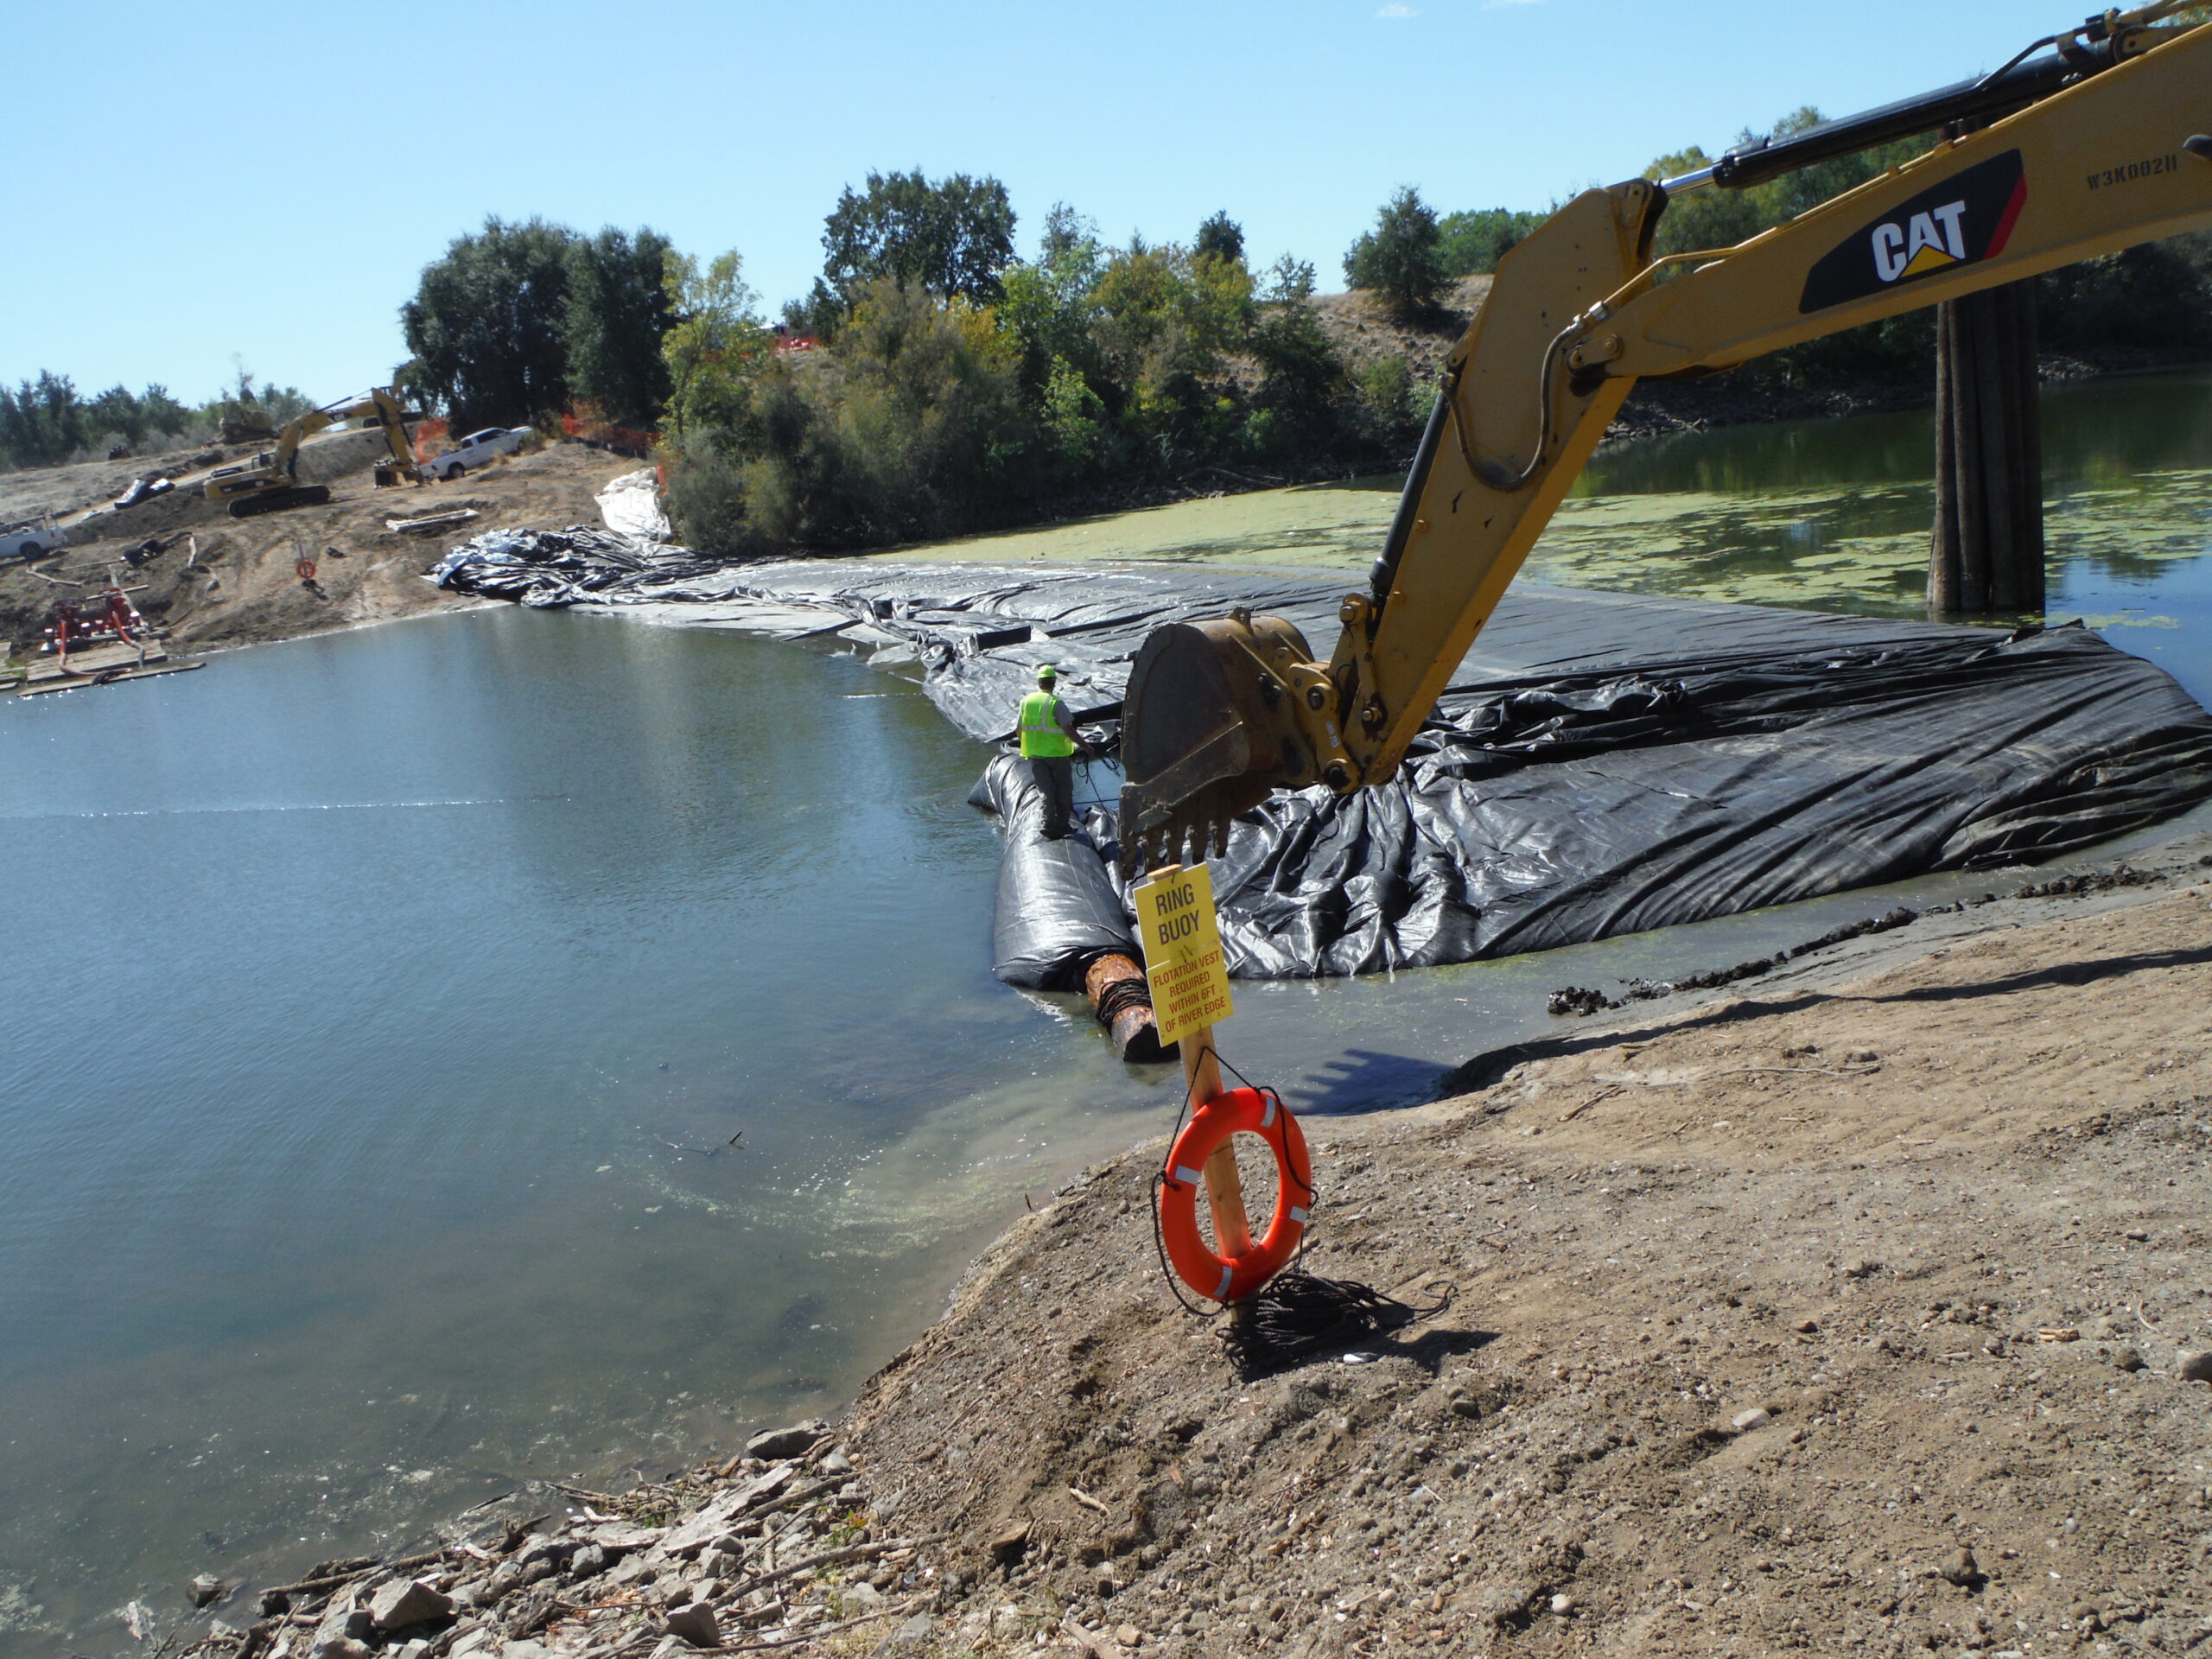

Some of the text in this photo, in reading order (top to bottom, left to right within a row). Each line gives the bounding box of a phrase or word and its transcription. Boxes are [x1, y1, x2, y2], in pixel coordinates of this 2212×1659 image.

[1872, 200, 1967, 283] CAT
[1156, 884, 1194, 916] RING
[1159, 910, 1199, 944] BUOY
[1154, 950, 1219, 988] FLOTATION VEST
[1170, 971, 1210, 997] REQUIRED
[1166, 997, 1225, 1033] OF RIVER EDGE
[1169, 985, 1216, 1014] WITHIN 6FT
